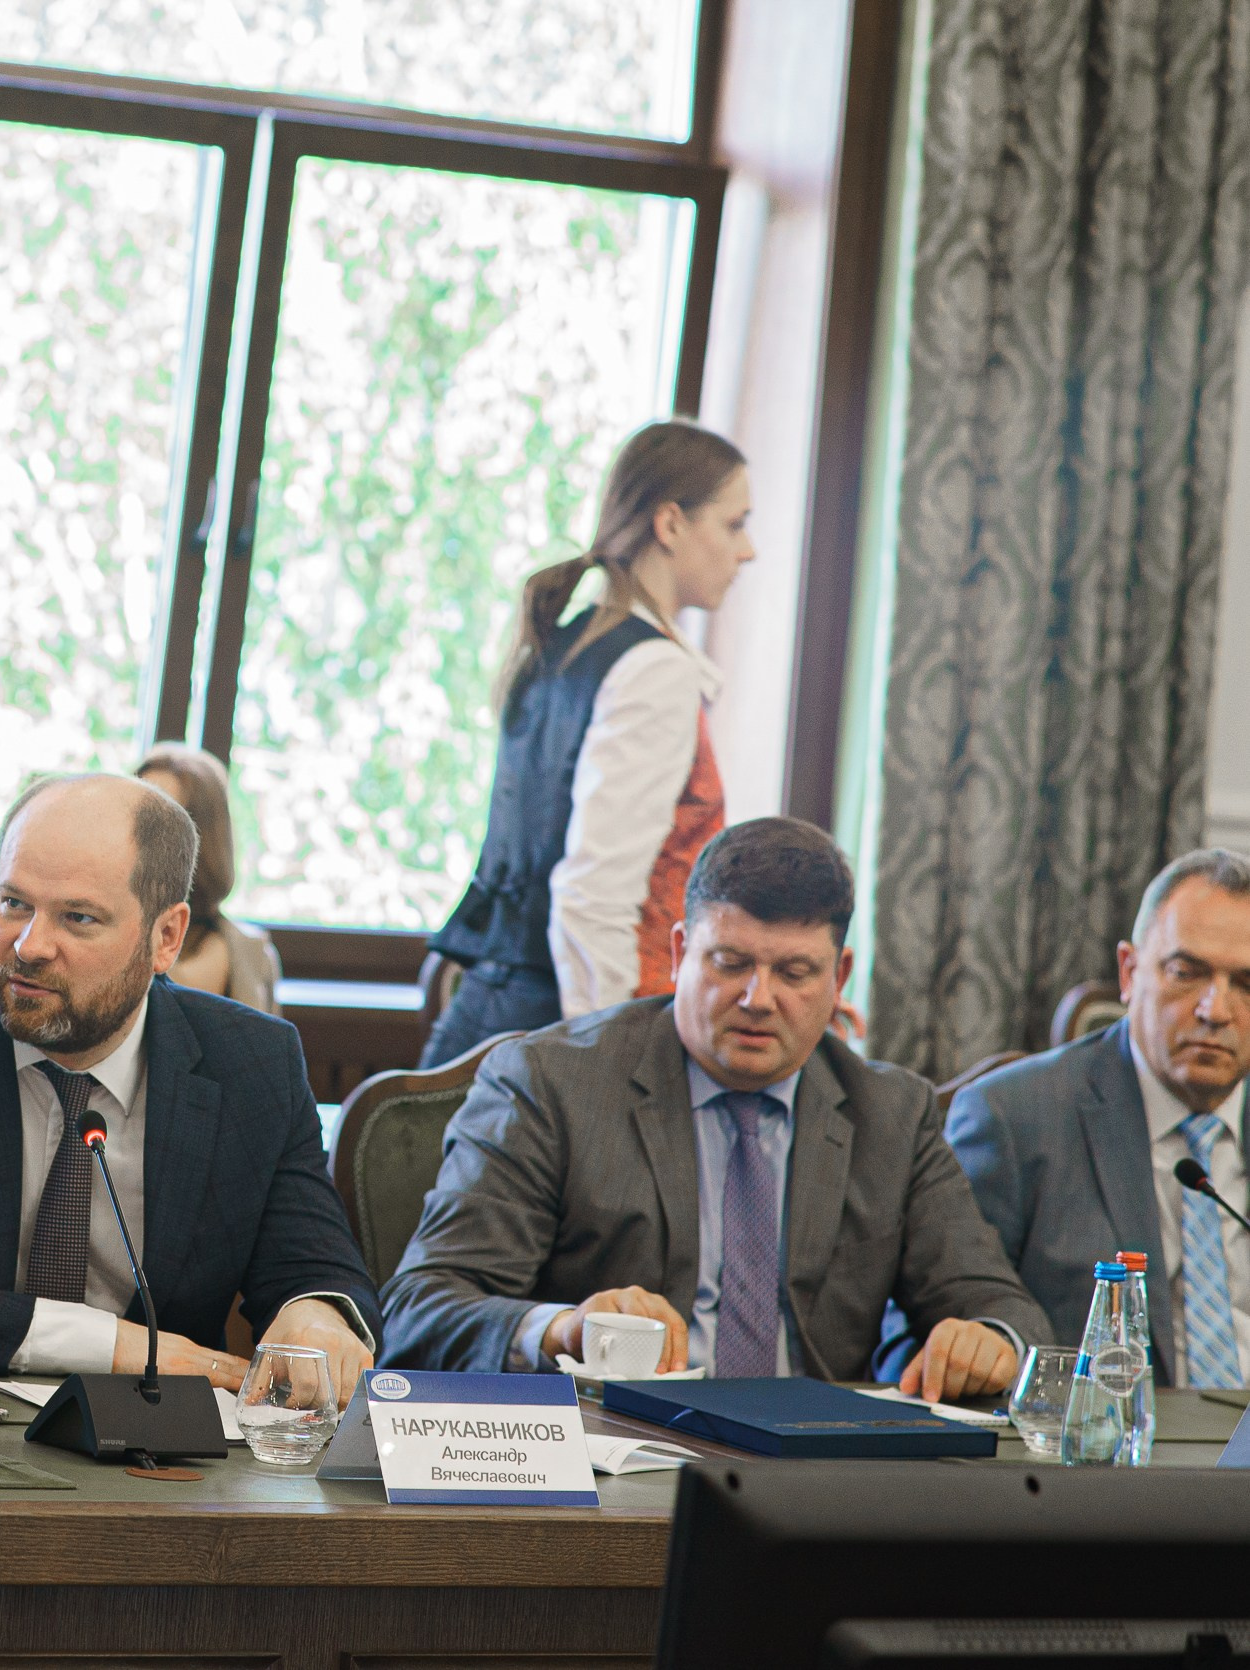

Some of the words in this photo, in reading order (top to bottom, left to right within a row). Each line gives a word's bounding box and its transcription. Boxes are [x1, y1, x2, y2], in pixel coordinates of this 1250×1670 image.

[391, 1417, 566, 1442] НАРУКАВНИКОВ
[441, 1445, 528, 1466] Александр
[430, 1466, 547, 1485] Вячеславович
